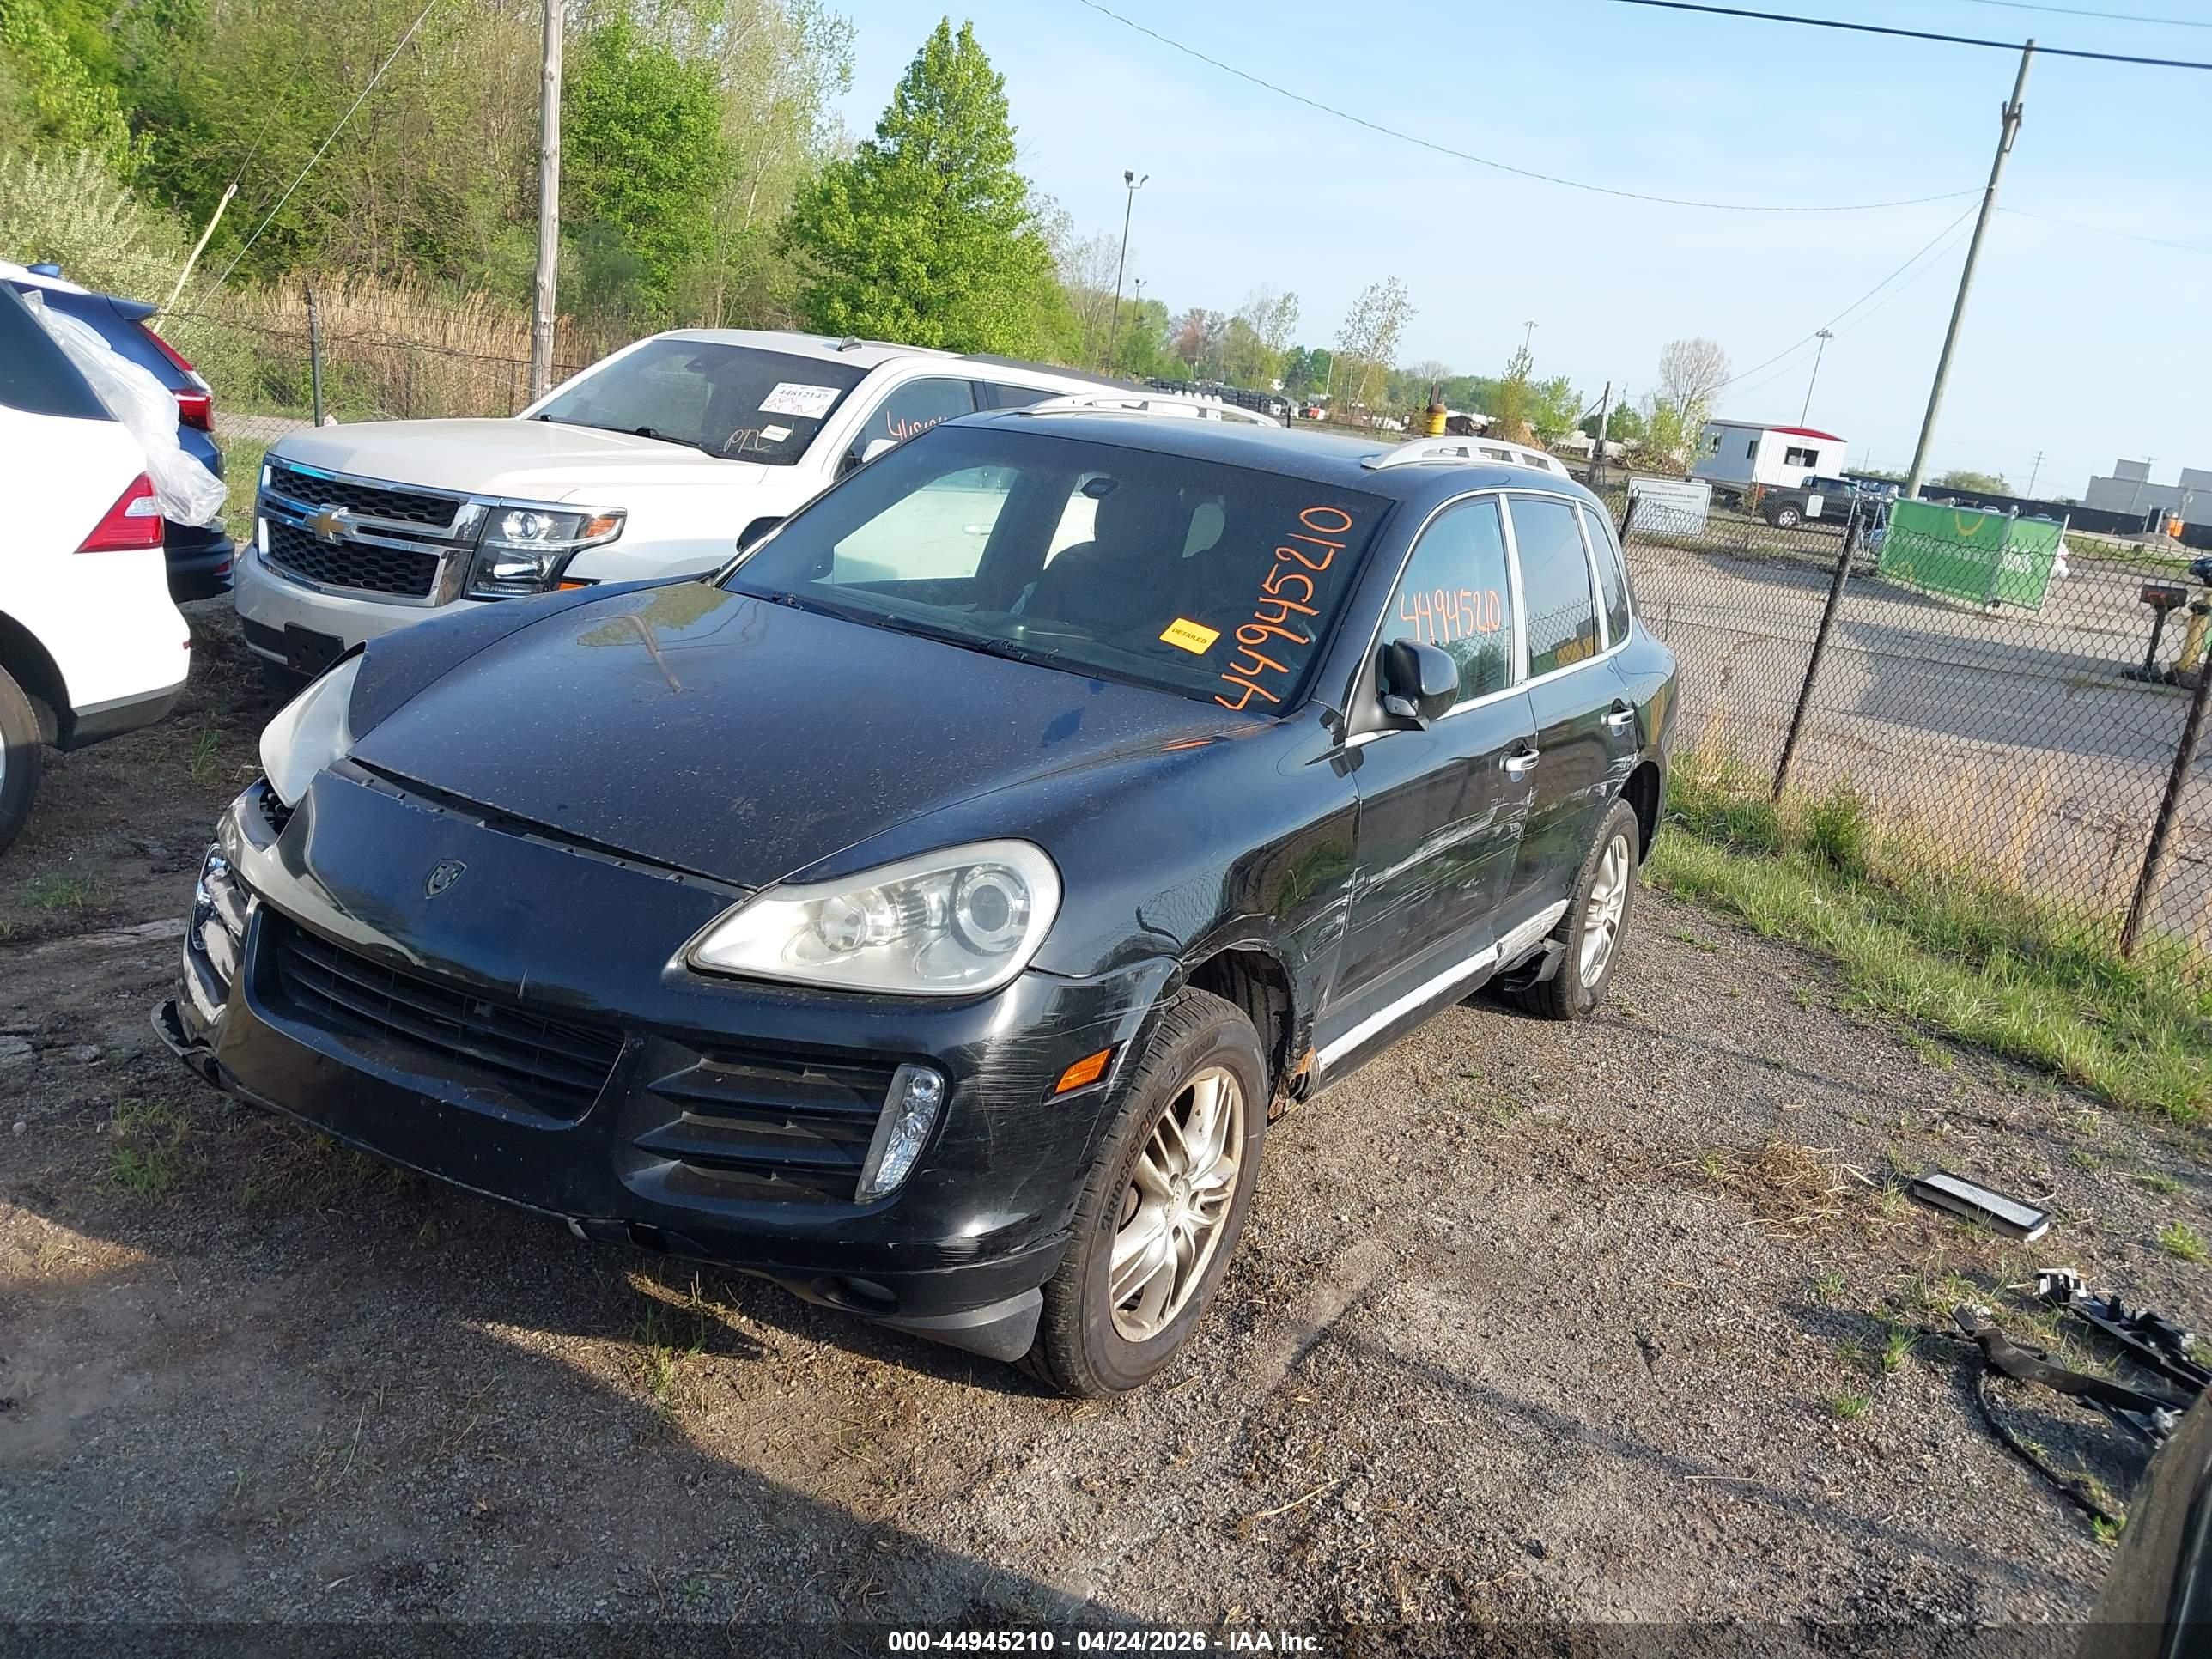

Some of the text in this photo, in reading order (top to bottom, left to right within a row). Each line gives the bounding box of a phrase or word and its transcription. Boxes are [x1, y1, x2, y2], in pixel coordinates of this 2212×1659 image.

[1171, 628, 1207, 644] DETAILED
[1213, 507, 1353, 711] 44945210
[1400, 589, 1501, 645] 44945210
[1100, 1098, 1160, 1233] BRIDGESTONE
